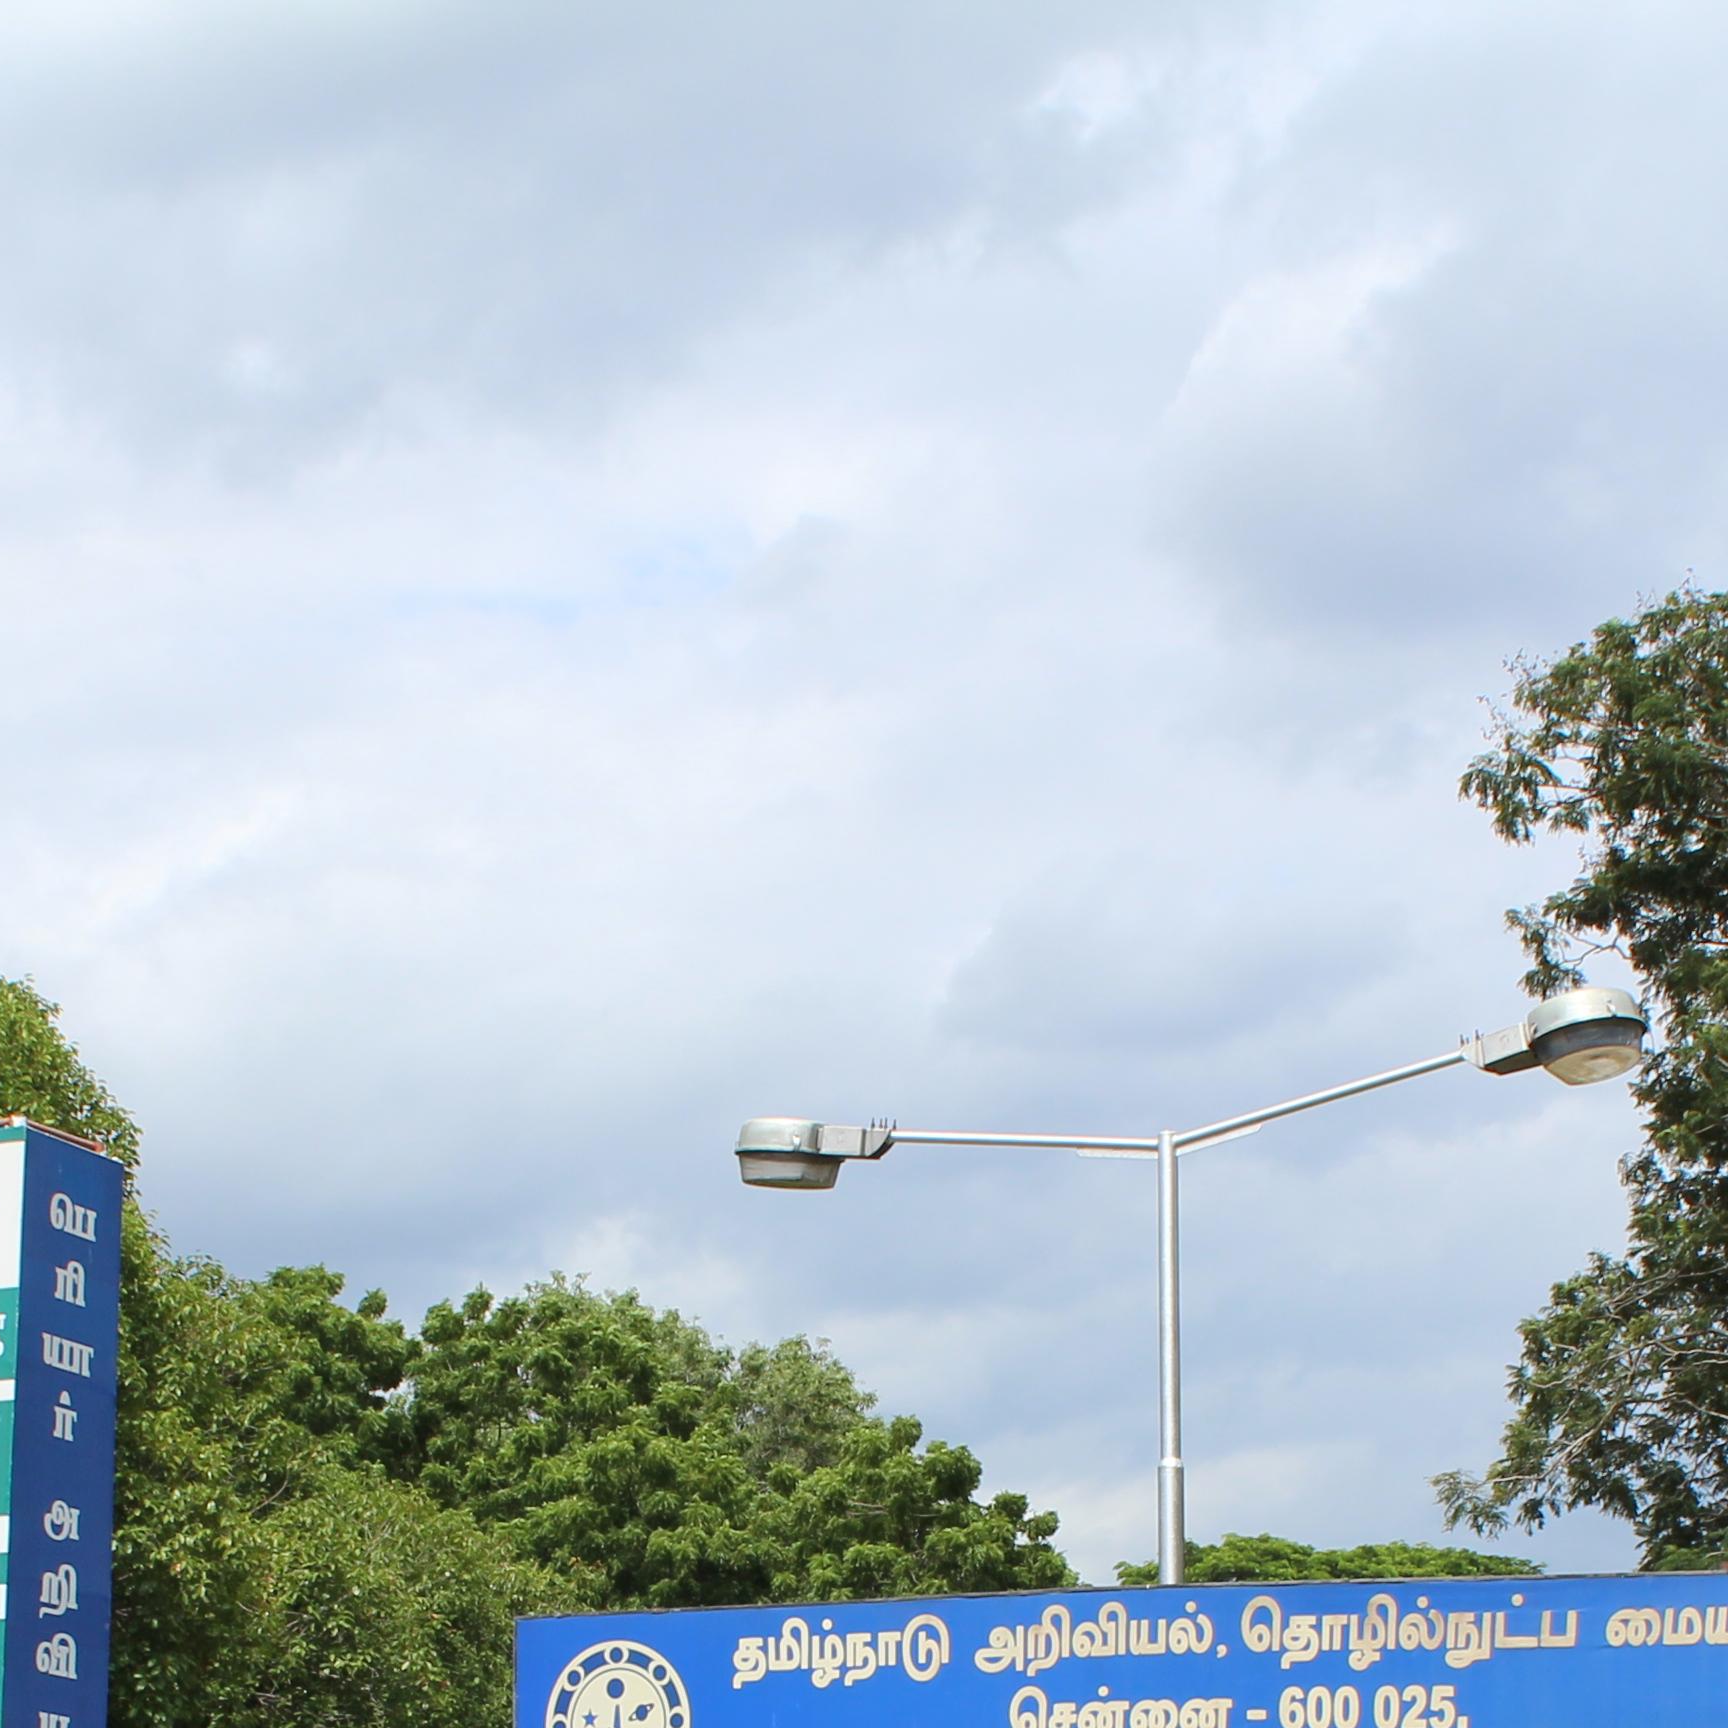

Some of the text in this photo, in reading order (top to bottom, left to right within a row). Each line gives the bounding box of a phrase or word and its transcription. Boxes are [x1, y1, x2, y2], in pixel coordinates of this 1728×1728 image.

[731, 1612, 950, 1690] தமிழ்நாடு
[974, 1600, 1228, 1678] அறிவியல்,
[1240, 1592, 1578, 1672] தொழில்நுட்ப
